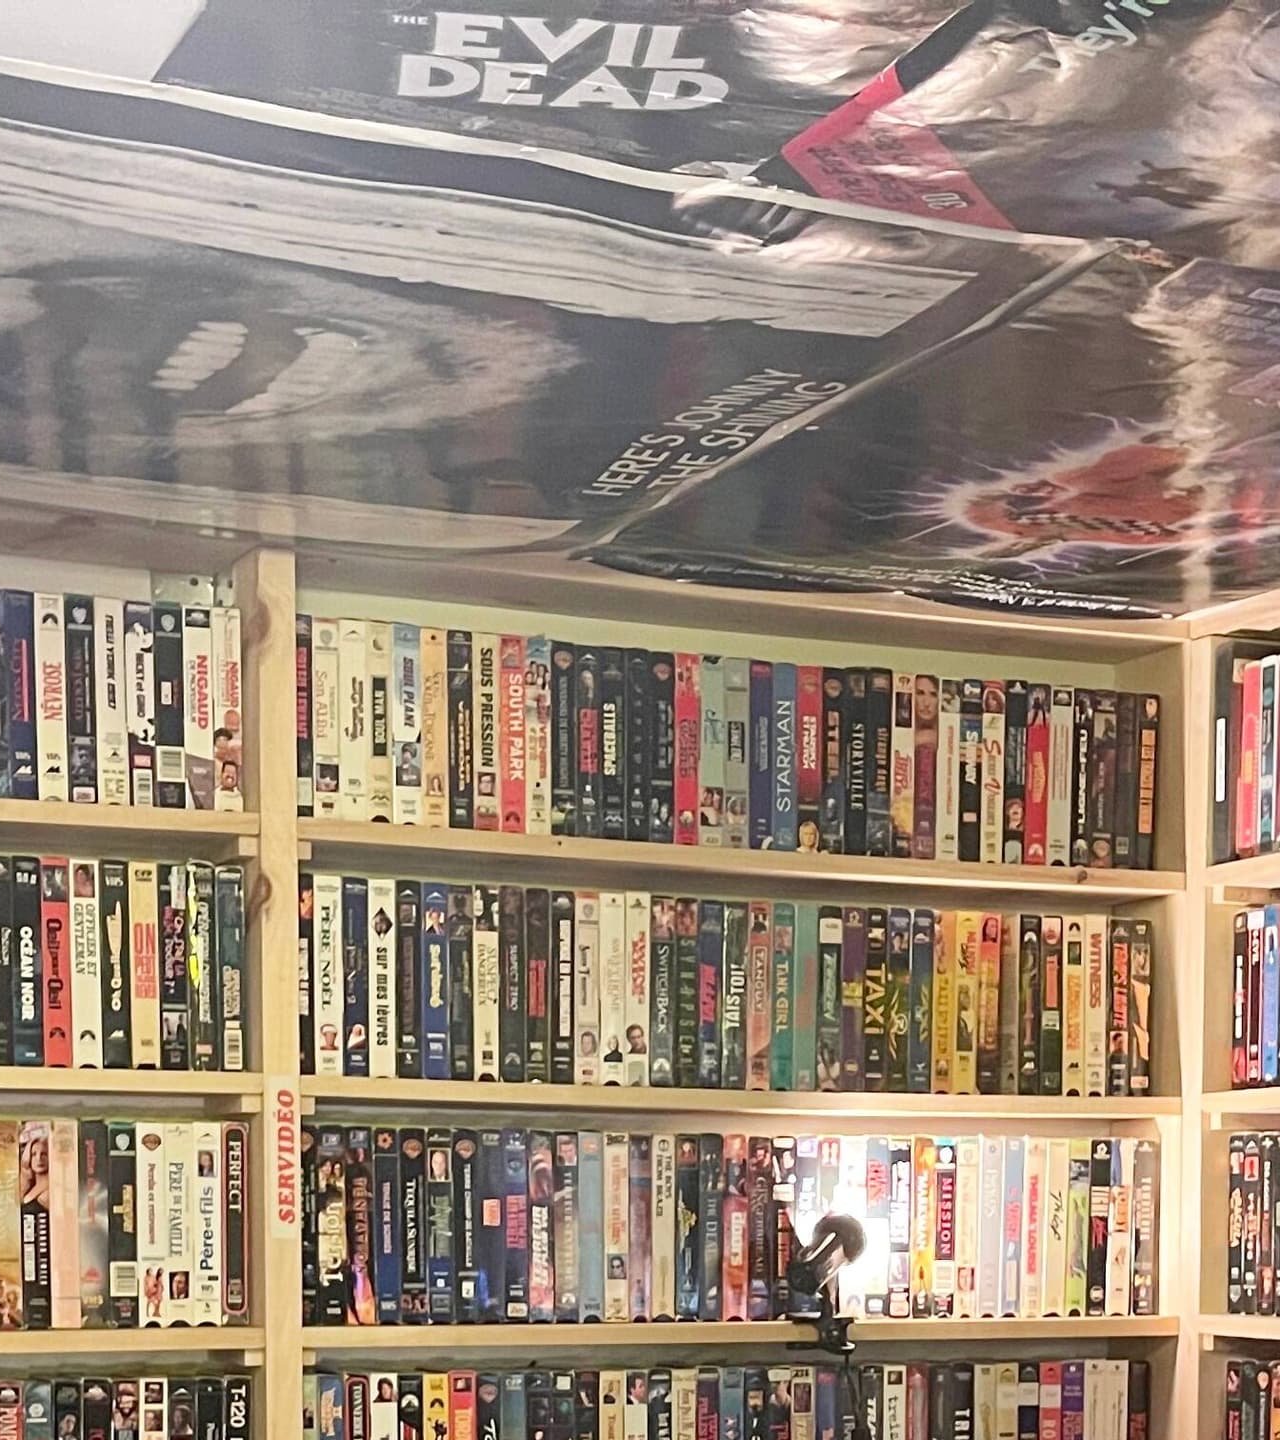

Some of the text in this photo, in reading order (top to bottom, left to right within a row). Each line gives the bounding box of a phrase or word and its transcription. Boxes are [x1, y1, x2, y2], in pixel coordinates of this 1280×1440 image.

[392, 15, 427, 26] THE
[431, 11, 706, 71] EVIL
[396, 53, 730, 110] DEAD
[582, 368, 802, 496] HERE'S JOHNNY
[648, 381, 846, 490] THE SHINING
[43, 661, 64, 720] NÉVROSE
[195, 655, 208, 729] NIGAUD
[481, 648, 494, 768] SOUS PRESSION
[510, 674, 526, 781] SOUTH PARK
[776, 699, 792, 812] STARMAN
[21, 927, 36, 1021] OCÉAN NOIR
[75, 903, 85, 975] GENTLEMAN
[85, 903, 99, 978] OFFICIER ET
[1089, 933, 1103, 1009] WITNESS
[375, 946, 388, 1047] sur mes lèvres
[228, 1140, 241, 1214] PERFECT
[273, 1090, 295, 1226] SERVIDÉO
[199, 1186, 213, 1213] fils
[940, 1178, 951, 1255] MISSION
[199, 1229, 214, 1271] Père
[229, 1384, 247, 1428] T-120
